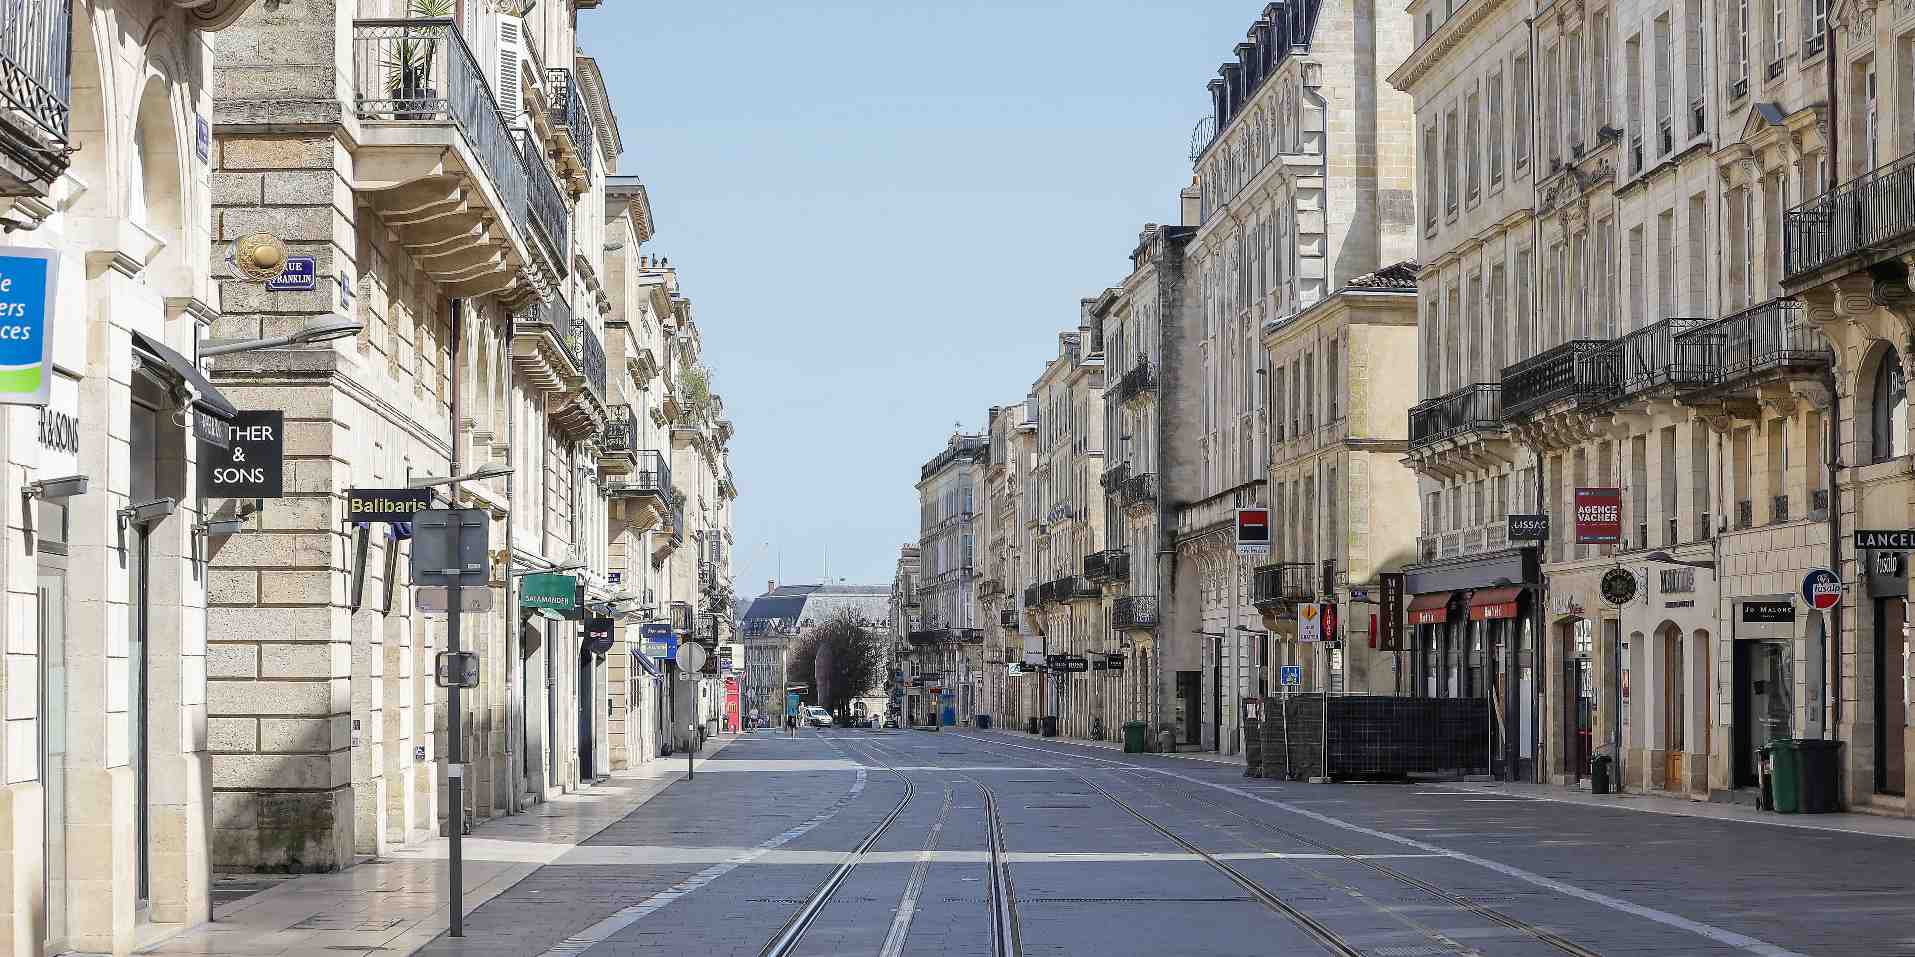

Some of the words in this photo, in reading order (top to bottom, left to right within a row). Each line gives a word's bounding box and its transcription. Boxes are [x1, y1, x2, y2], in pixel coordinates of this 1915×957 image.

[288, 262, 302, 271] UE
[271, 274, 312, 284] FRANKLIN
[55, 411, 79, 455] SONS
[228, 425, 274, 441] THER
[232, 448, 245, 462] &
[213, 468, 264, 484] SONS
[351, 498, 427, 513] Balibaris
[1577, 505, 1618, 514] AGENCE
[1577, 513, 1618, 522] VACHER
[1857, 533, 1915, 546] LANCEL
